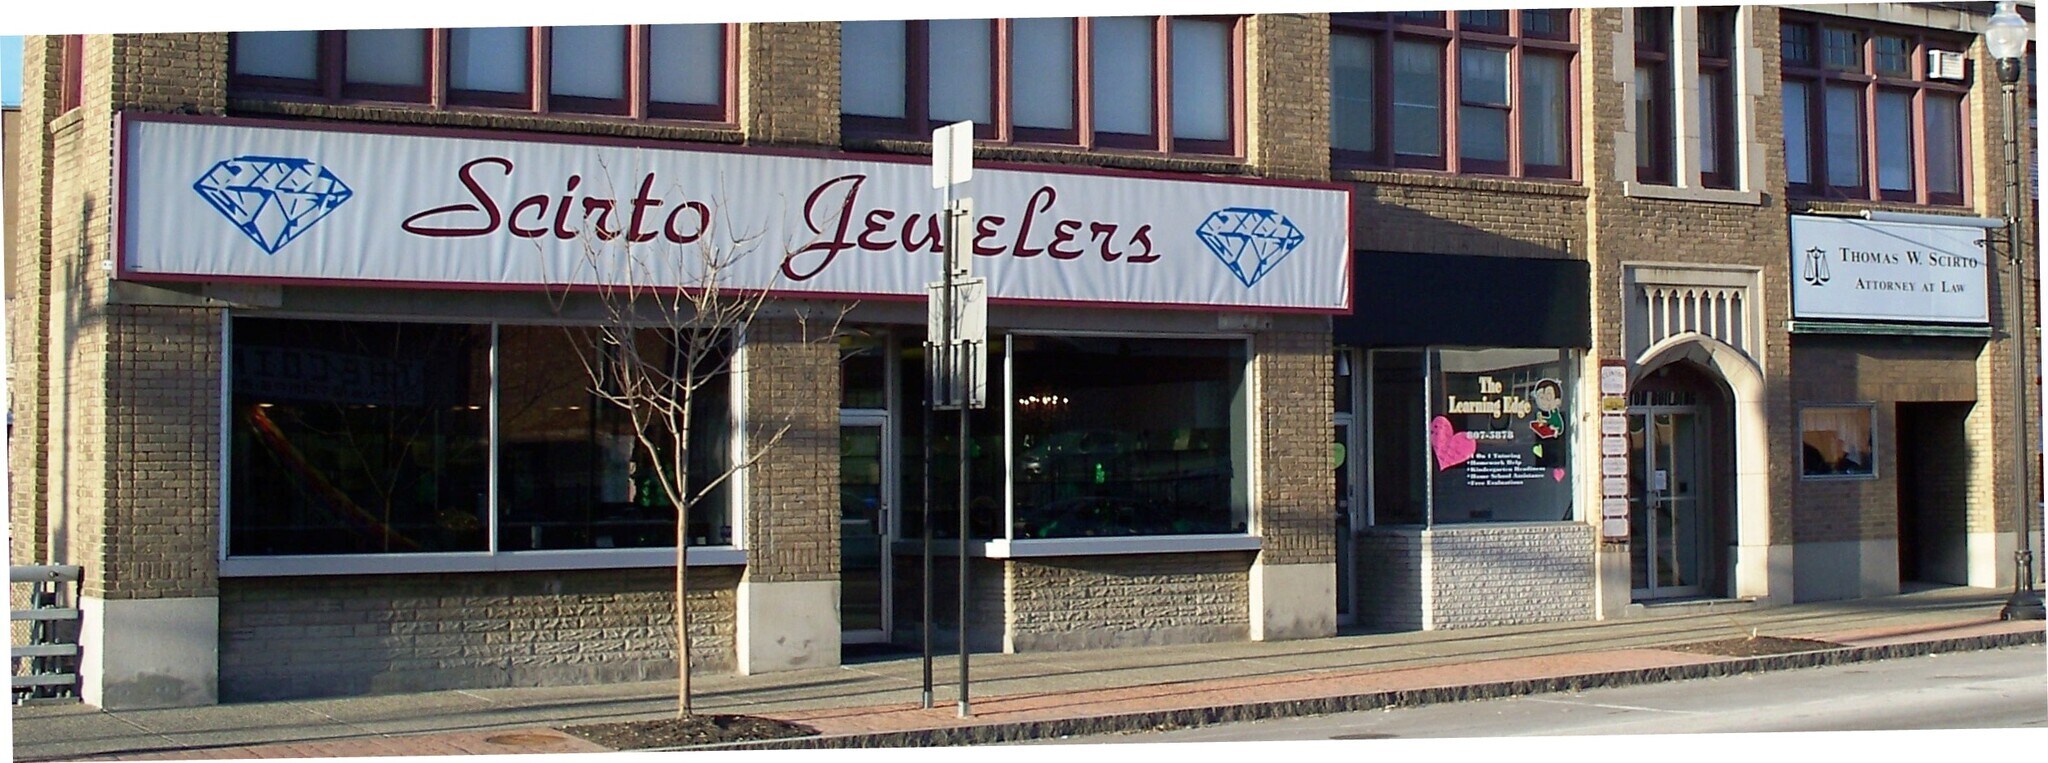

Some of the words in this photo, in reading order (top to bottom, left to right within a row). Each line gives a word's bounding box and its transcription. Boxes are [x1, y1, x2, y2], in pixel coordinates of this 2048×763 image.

[401, 157, 711, 245] Scirto
[782, 173, 1162, 282] Jewelers
[1839, 247, 1899, 265] THOMAS
[1906, 250, 1922, 266] W.
[1928, 252, 1978, 269] SCIRTO
[1855, 277, 1916, 292] ATTORNEY
[1922, 283, 1935, 293] AT
[1941, 281, 1965, 293] LAW
[1478, 376, 1503, 394] The
[1448, 395, 1501, 419] Learning
[1503, 395, 1532, 419] Edge
[1506, 459, 1522, 467] Help
